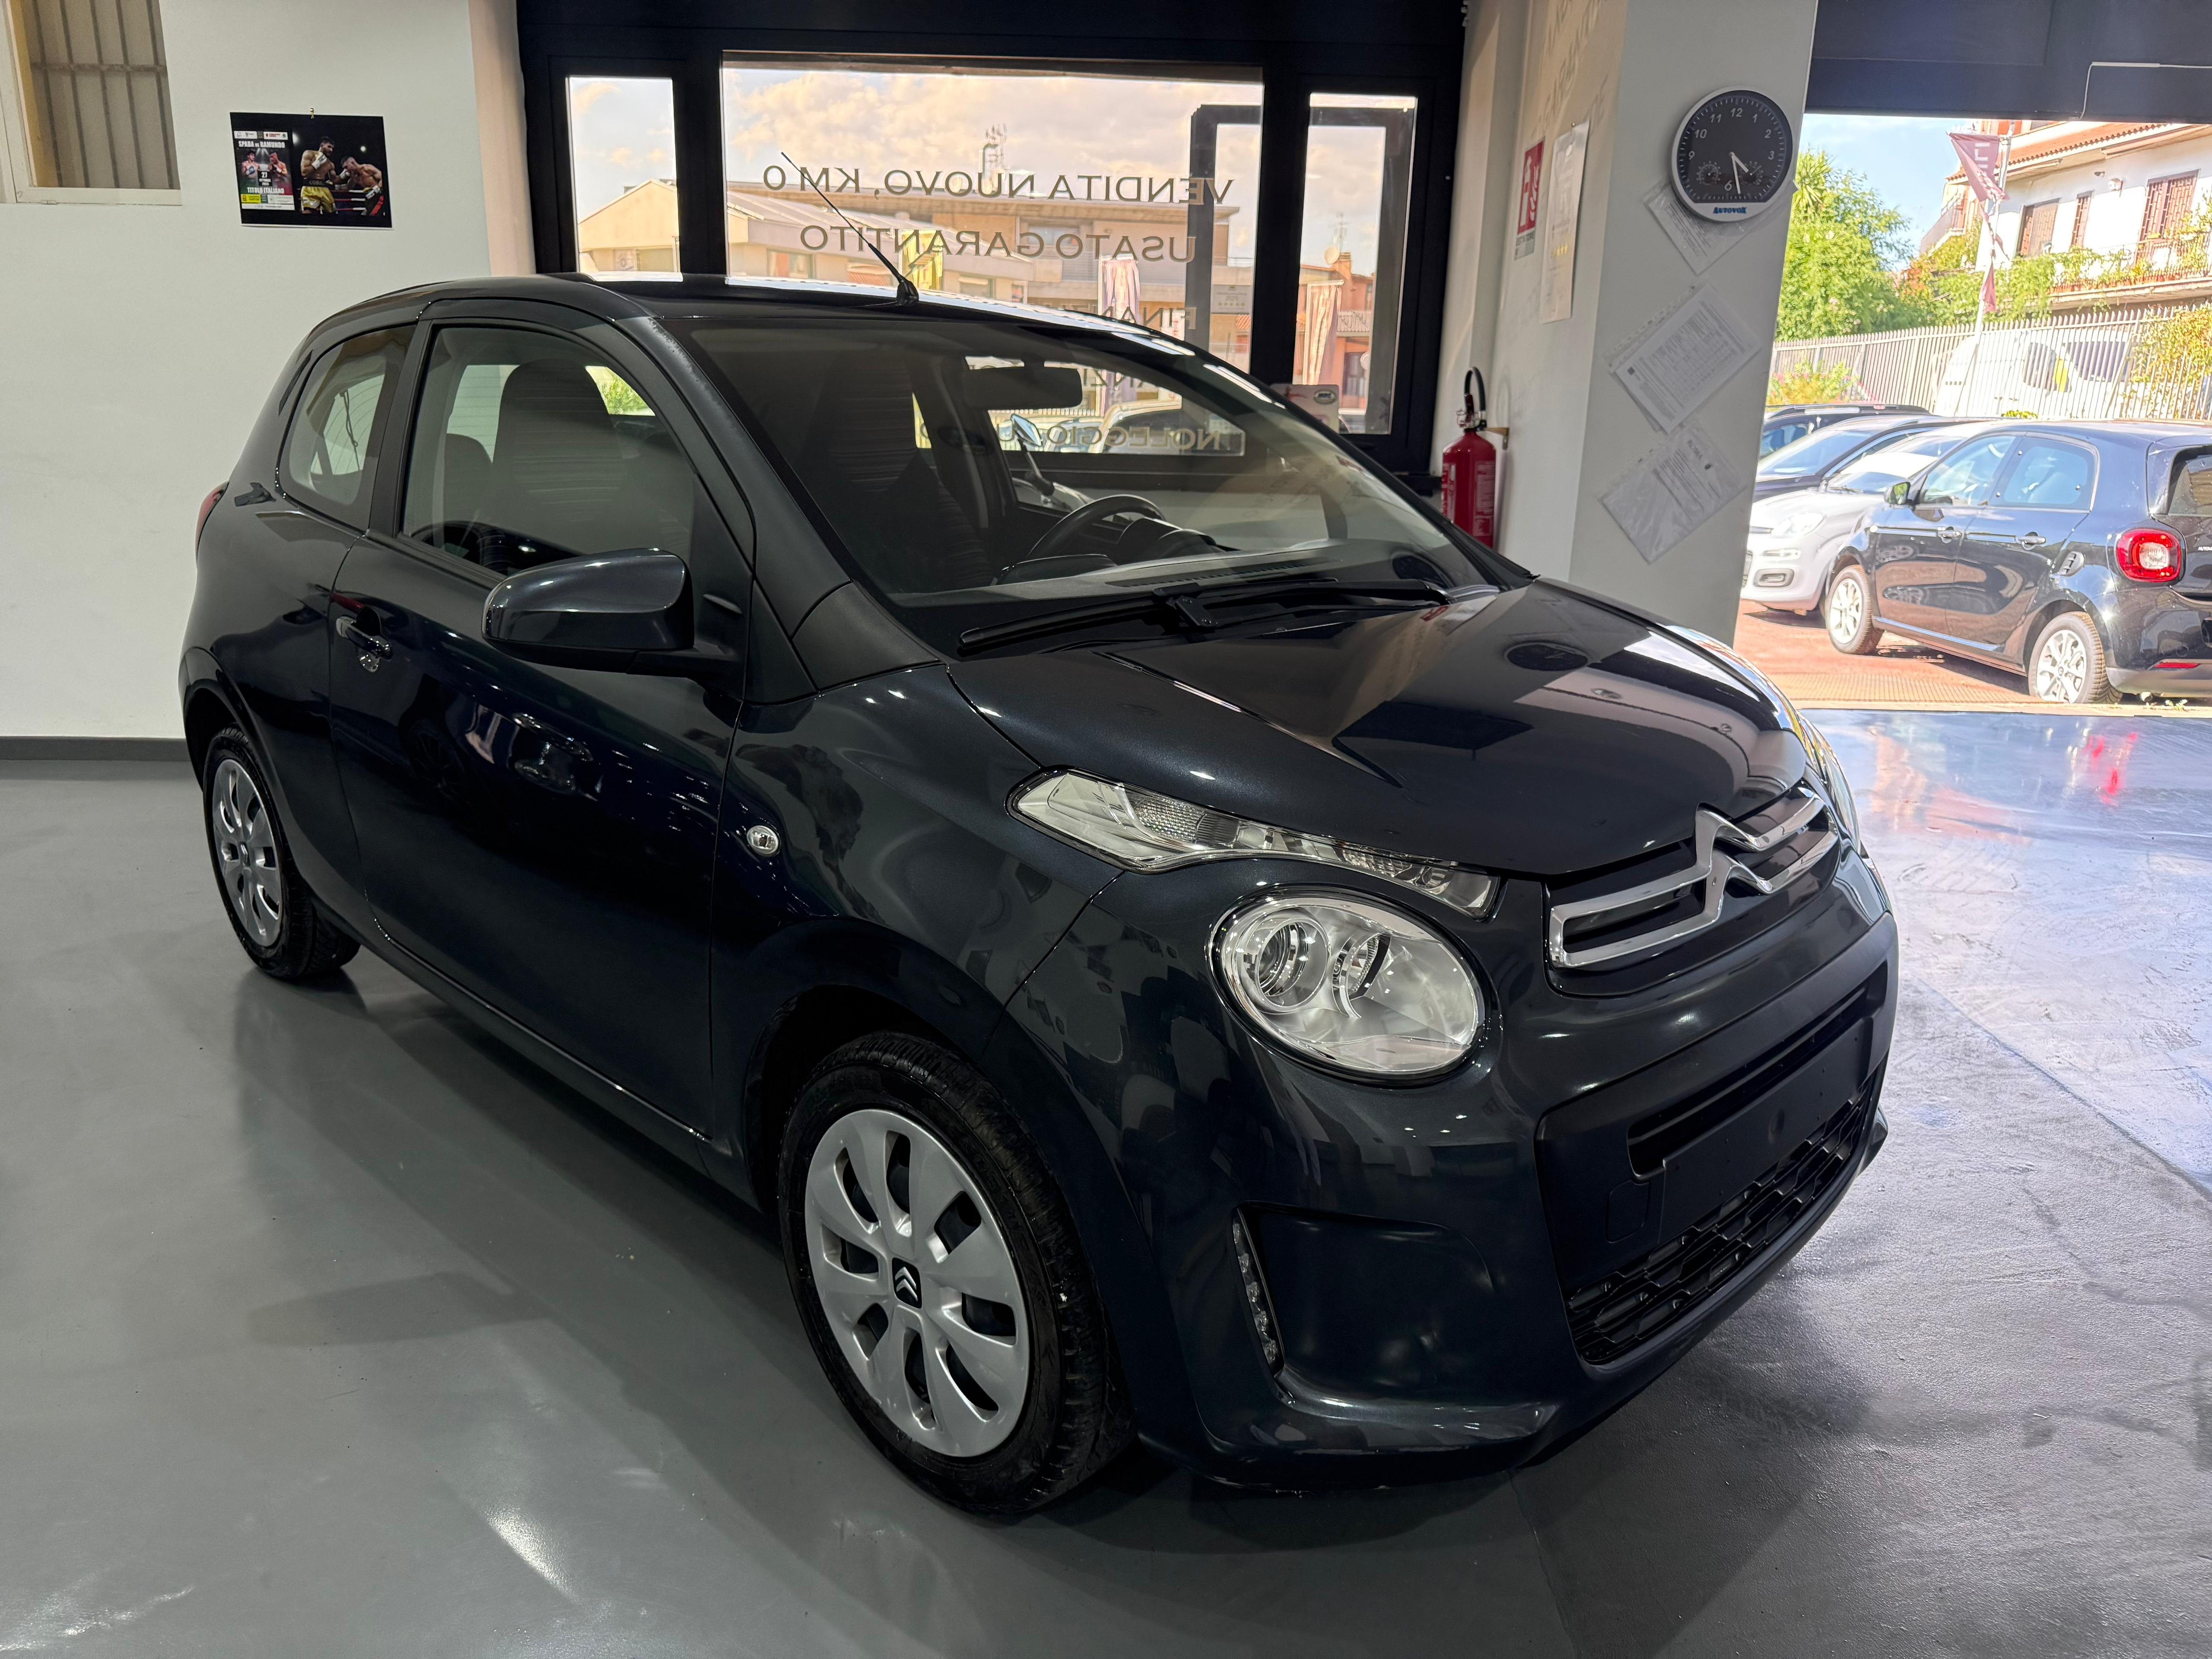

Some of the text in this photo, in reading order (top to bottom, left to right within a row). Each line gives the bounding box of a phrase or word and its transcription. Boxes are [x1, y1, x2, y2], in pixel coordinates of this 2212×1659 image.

[1730, 108, 1743, 118] 12
[1710, 114, 1722, 123] 11
[1752, 114, 1758, 123] 1
[1694, 129, 1707, 139] 10
[1764, 129, 1771, 138] 2
[1688, 151, 1695, 160] 9
[1768, 151, 1774, 160] 3
[1724, 180, 1732, 191] 6
